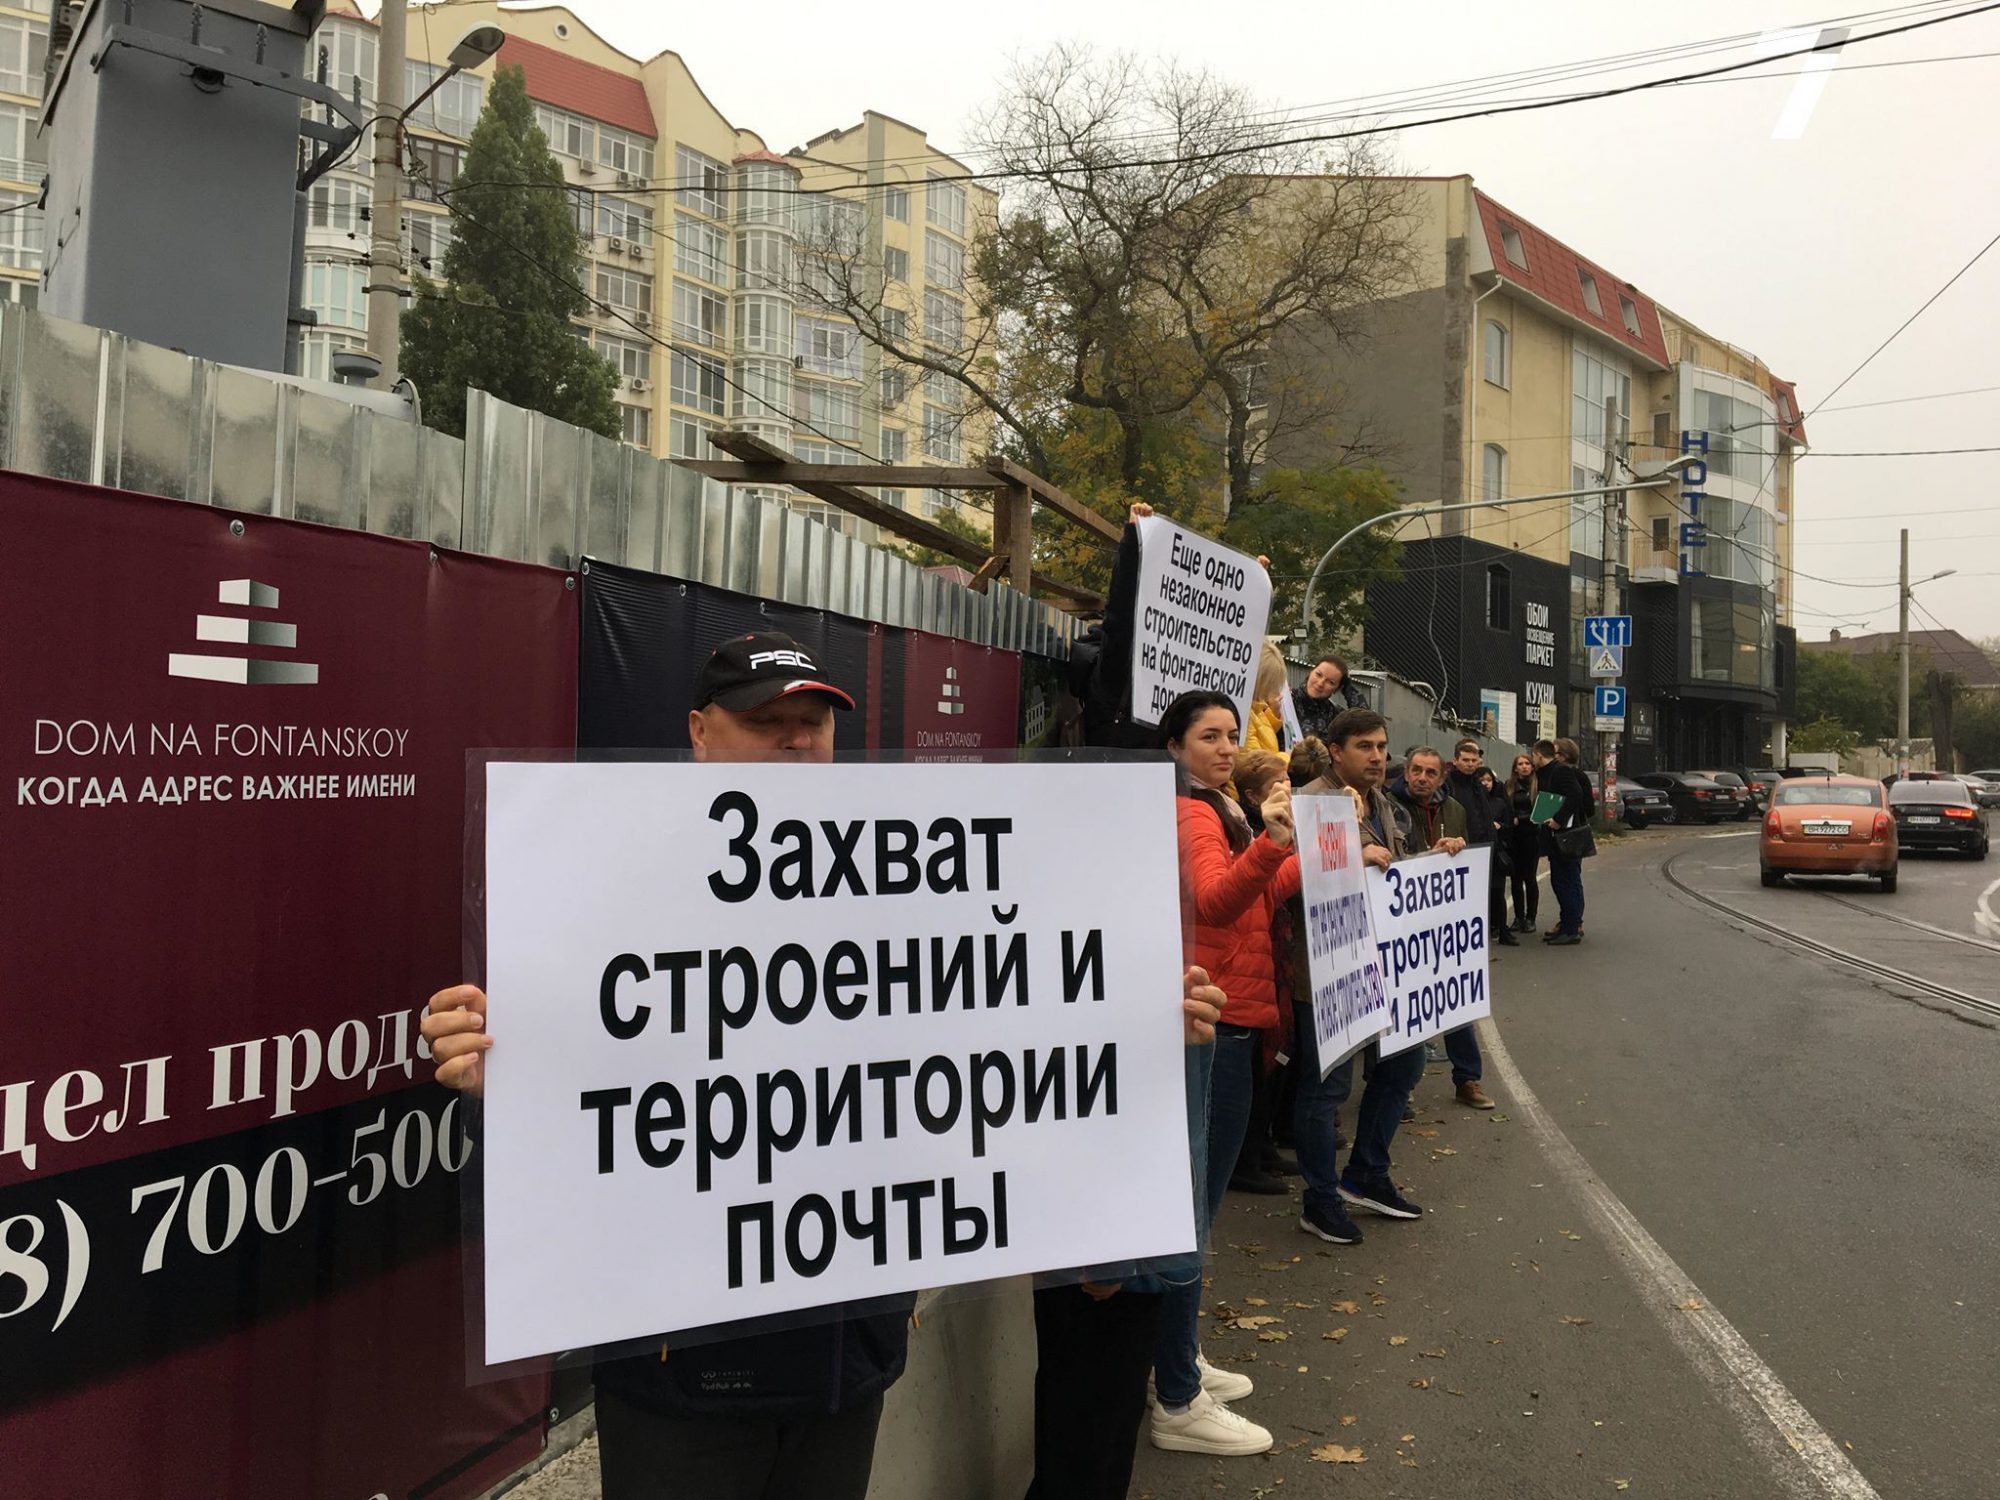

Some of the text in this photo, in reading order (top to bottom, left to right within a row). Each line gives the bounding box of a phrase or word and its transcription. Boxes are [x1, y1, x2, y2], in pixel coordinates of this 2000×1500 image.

[1680, 431, 1709, 577] HOTEL
[1170, 532, 1245, 592] Еще одно
[1159, 574, 1246, 628] незаконное
[1526, 602, 1549, 629] ОБОИ
[1144, 605, 1253, 666] строительство
[1526, 643, 1555, 668] ПАРКЕТ
[1142, 642, 1247, 699] на фонтанской
[1525, 681, 1555, 705] КУХНИ
[34, 719, 409, 758] DOM NA FONTANSKOY
[917, 730, 934, 747] DOM
[17, 774, 416, 808] КОГДА АДРЕС ВАЖНЕЕ ИМЕНИ
[707, 790, 1013, 904] Захват
[1385, 866, 1470, 918] Захват
[1377, 916, 1484, 988] тротуара
[599, 903, 1105, 1060] строений и
[1406, 969, 1484, 1038] дороги
[580, 1042, 1119, 1194] территории
[727, 1170, 1009, 1289] почты
